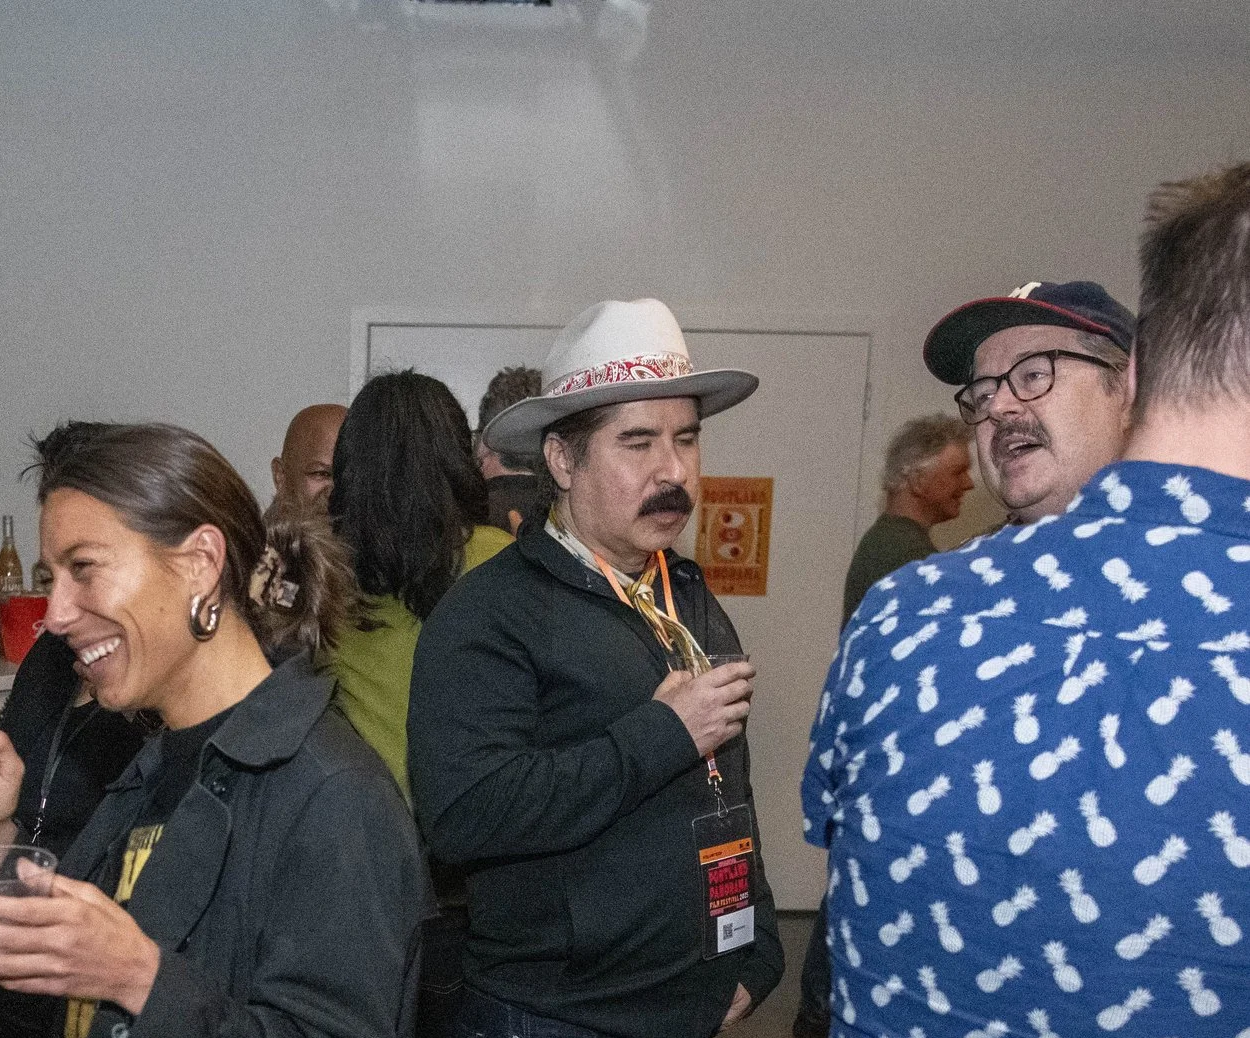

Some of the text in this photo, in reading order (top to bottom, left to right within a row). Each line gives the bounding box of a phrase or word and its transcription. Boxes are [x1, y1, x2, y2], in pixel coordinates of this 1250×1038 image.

[708, 861, 748, 884] PORTLAND
[709, 878, 748, 899] PANORAMA
[720, 895, 739, 906] FESTIVAL
